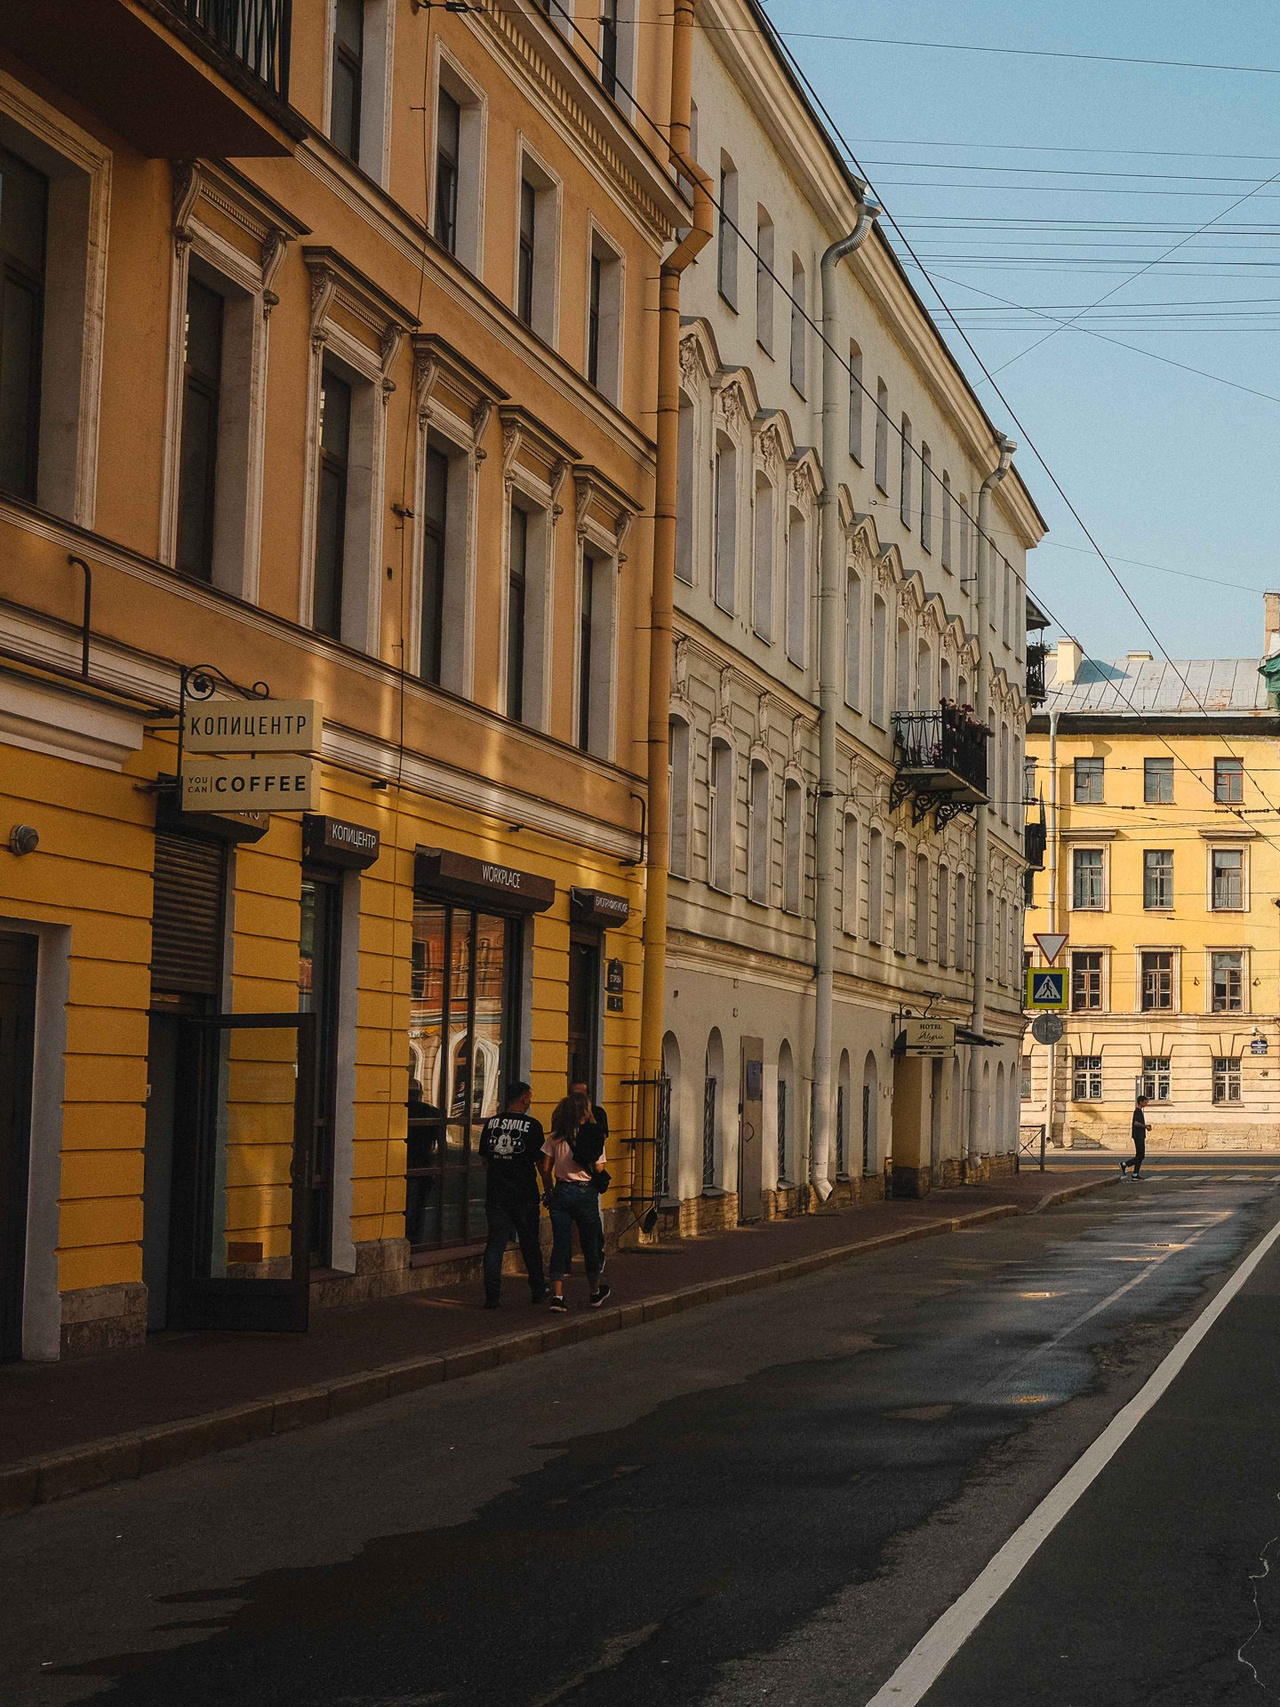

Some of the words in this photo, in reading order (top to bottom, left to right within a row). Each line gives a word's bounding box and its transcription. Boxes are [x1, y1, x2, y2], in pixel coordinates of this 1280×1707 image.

[191, 716, 306, 736] КОПИЦЕНТР
[215, 776, 306, 792] COFFEE
[332, 824, 376, 849] КОПИЦЕНТР
[482, 865, 520, 888] WORKPLACE
[487, 1118, 500, 1129] NO
[501, 1118, 531, 1133] SMILE
